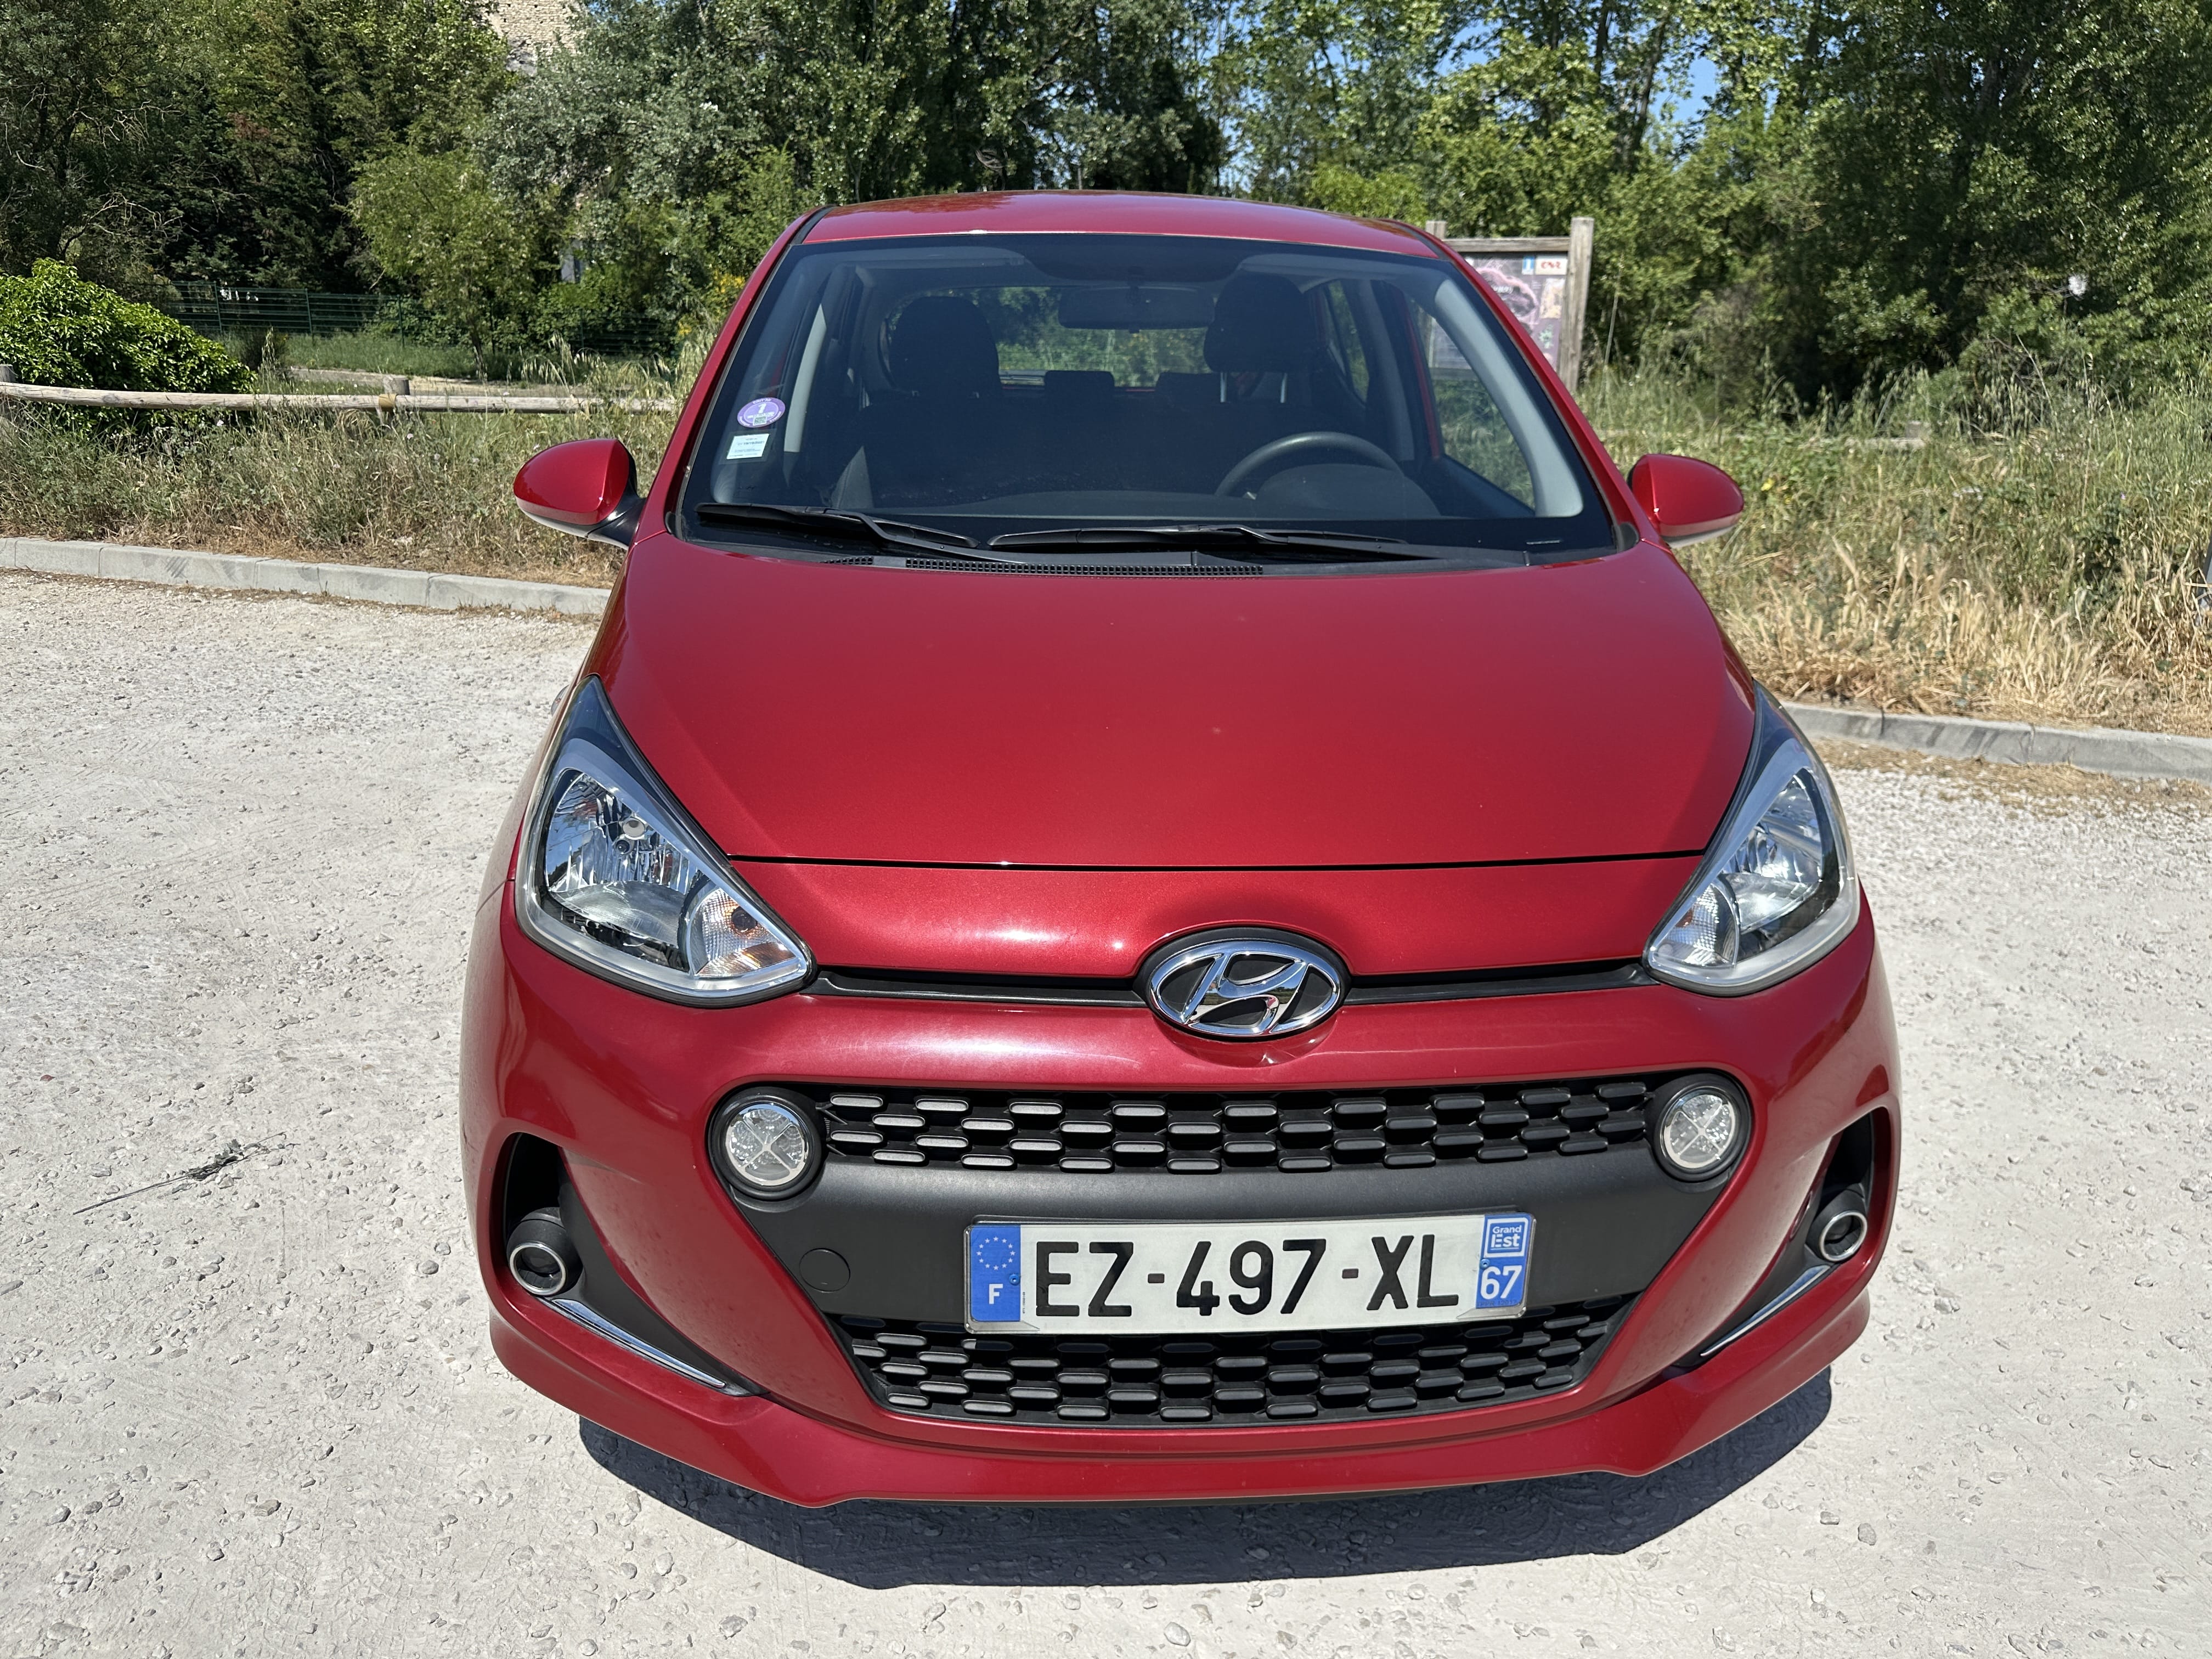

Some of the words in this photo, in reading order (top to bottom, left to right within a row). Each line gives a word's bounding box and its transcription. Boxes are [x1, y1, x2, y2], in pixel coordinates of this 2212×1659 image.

[758, 403, 767, 414] 1
[1492, 1225, 1522, 1234] Grand
[1491, 1233, 1521, 1248] Est
[1035, 1234, 1459, 1317] EZ-497-XL
[1480, 1265, 1522, 1300] 67
[989, 1284, 1003, 1305] F
